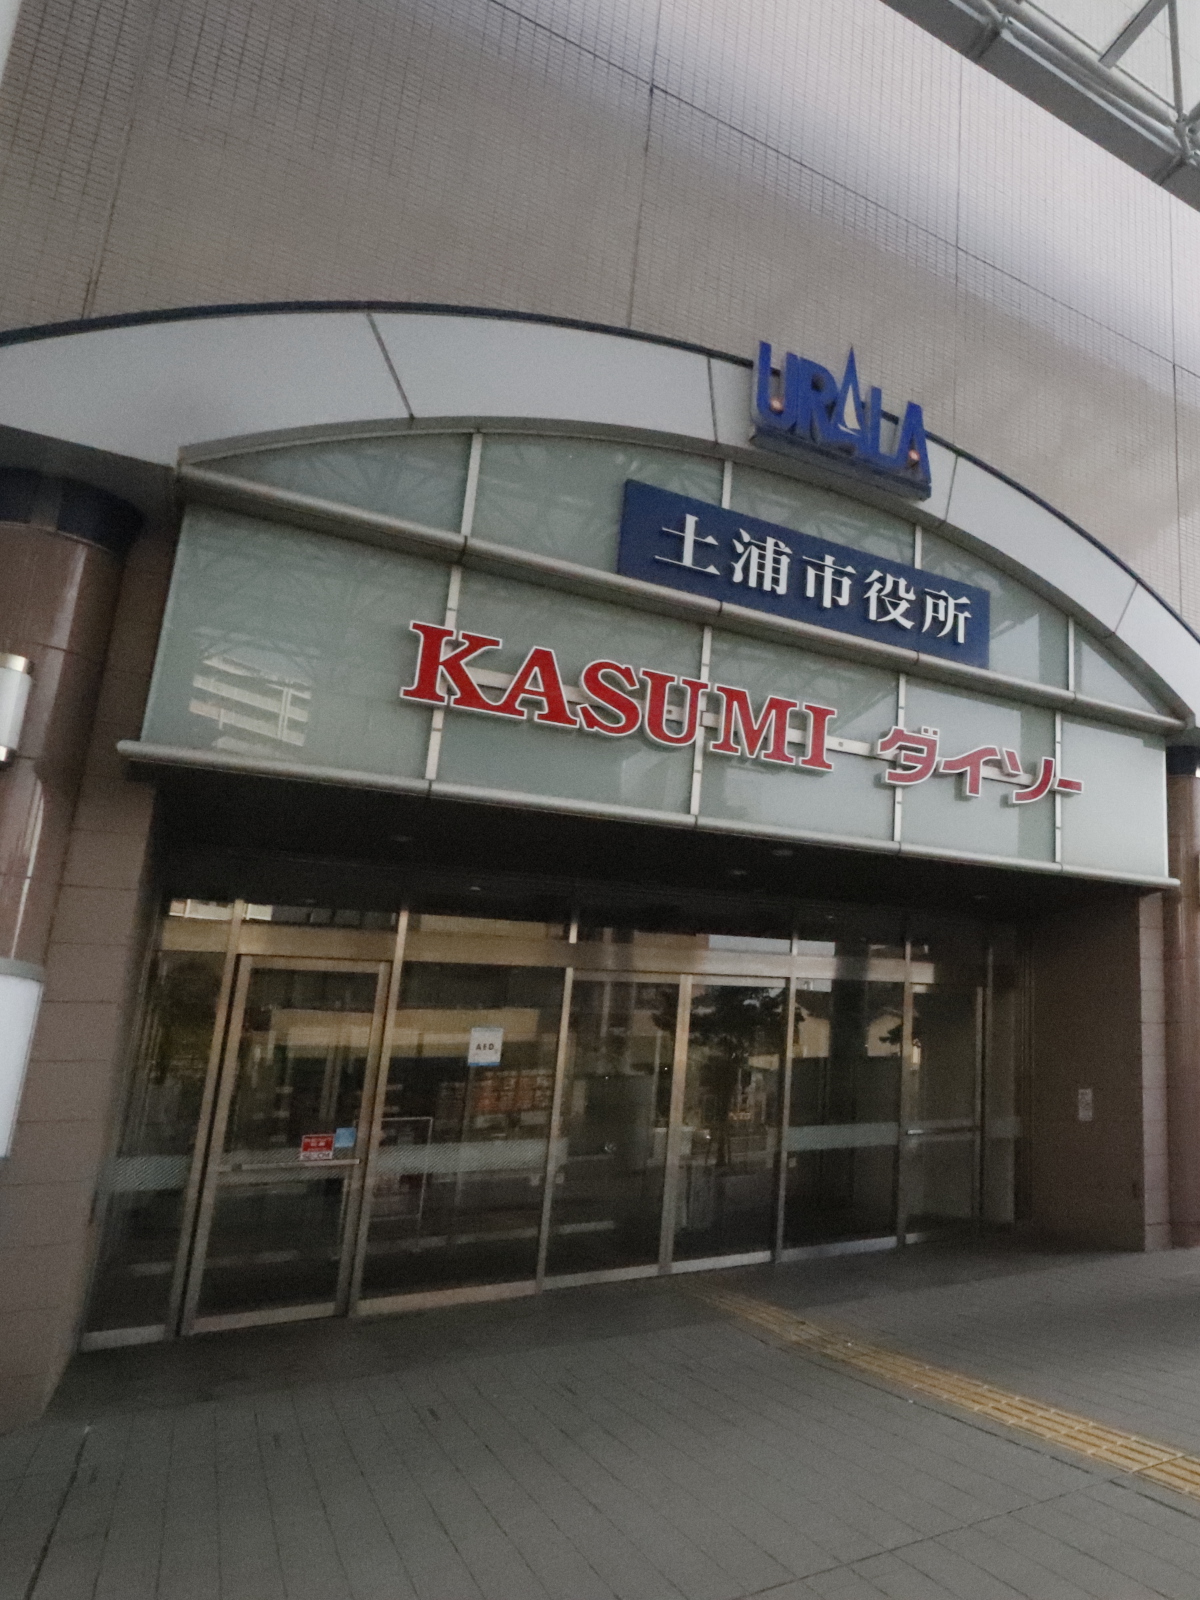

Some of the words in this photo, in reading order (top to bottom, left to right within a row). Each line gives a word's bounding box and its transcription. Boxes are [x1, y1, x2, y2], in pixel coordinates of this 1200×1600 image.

[756, 340, 932, 484] URALA
[654, 513, 973, 646] 土浦市役所
[401, 620, 838, 773] KASUMI
[878, 725, 1085, 805] ダイソー
[476, 1043, 495, 1051] AED
